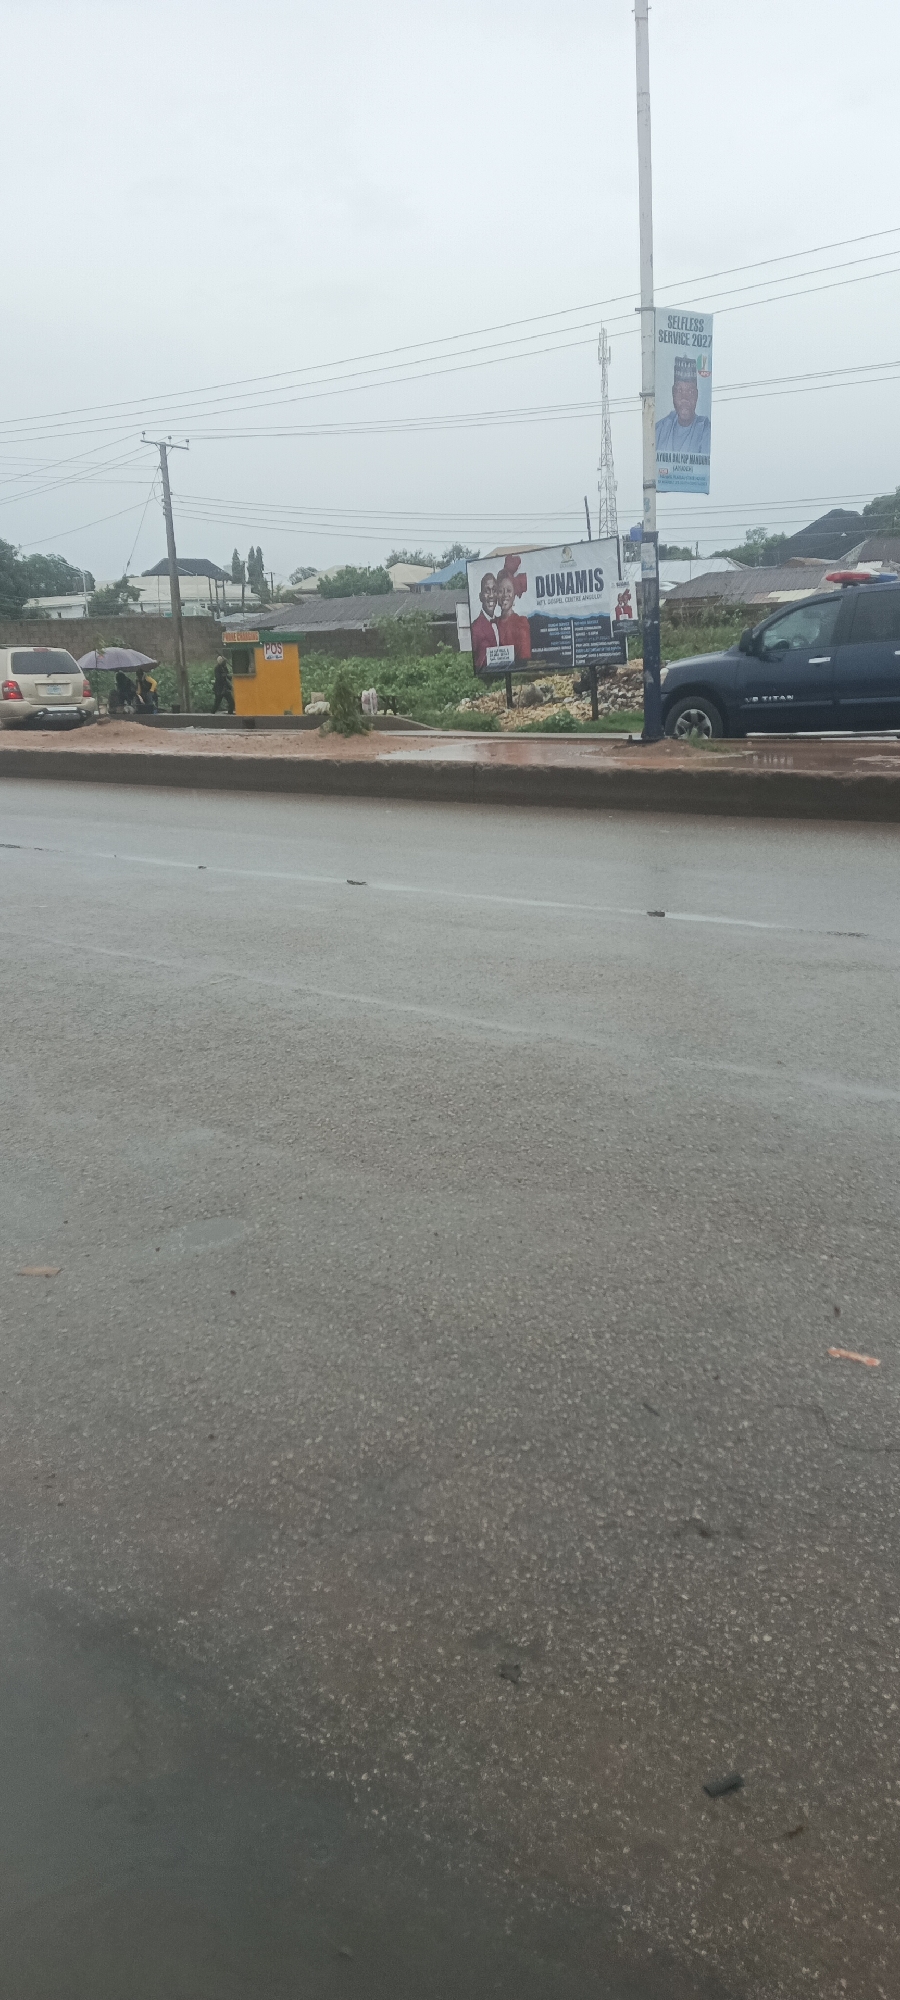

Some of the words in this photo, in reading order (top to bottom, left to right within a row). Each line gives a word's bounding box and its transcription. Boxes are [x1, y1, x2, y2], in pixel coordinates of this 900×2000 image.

[667, 315, 704, 332] SELFLESS
[658, 329, 690, 346] SERVICE
[691, 334, 712, 348] 2027
[535, 567, 604, 598] DUNAMIS
[265, 643, 282, 654] POS
[761, 694, 794, 702] TITAN
